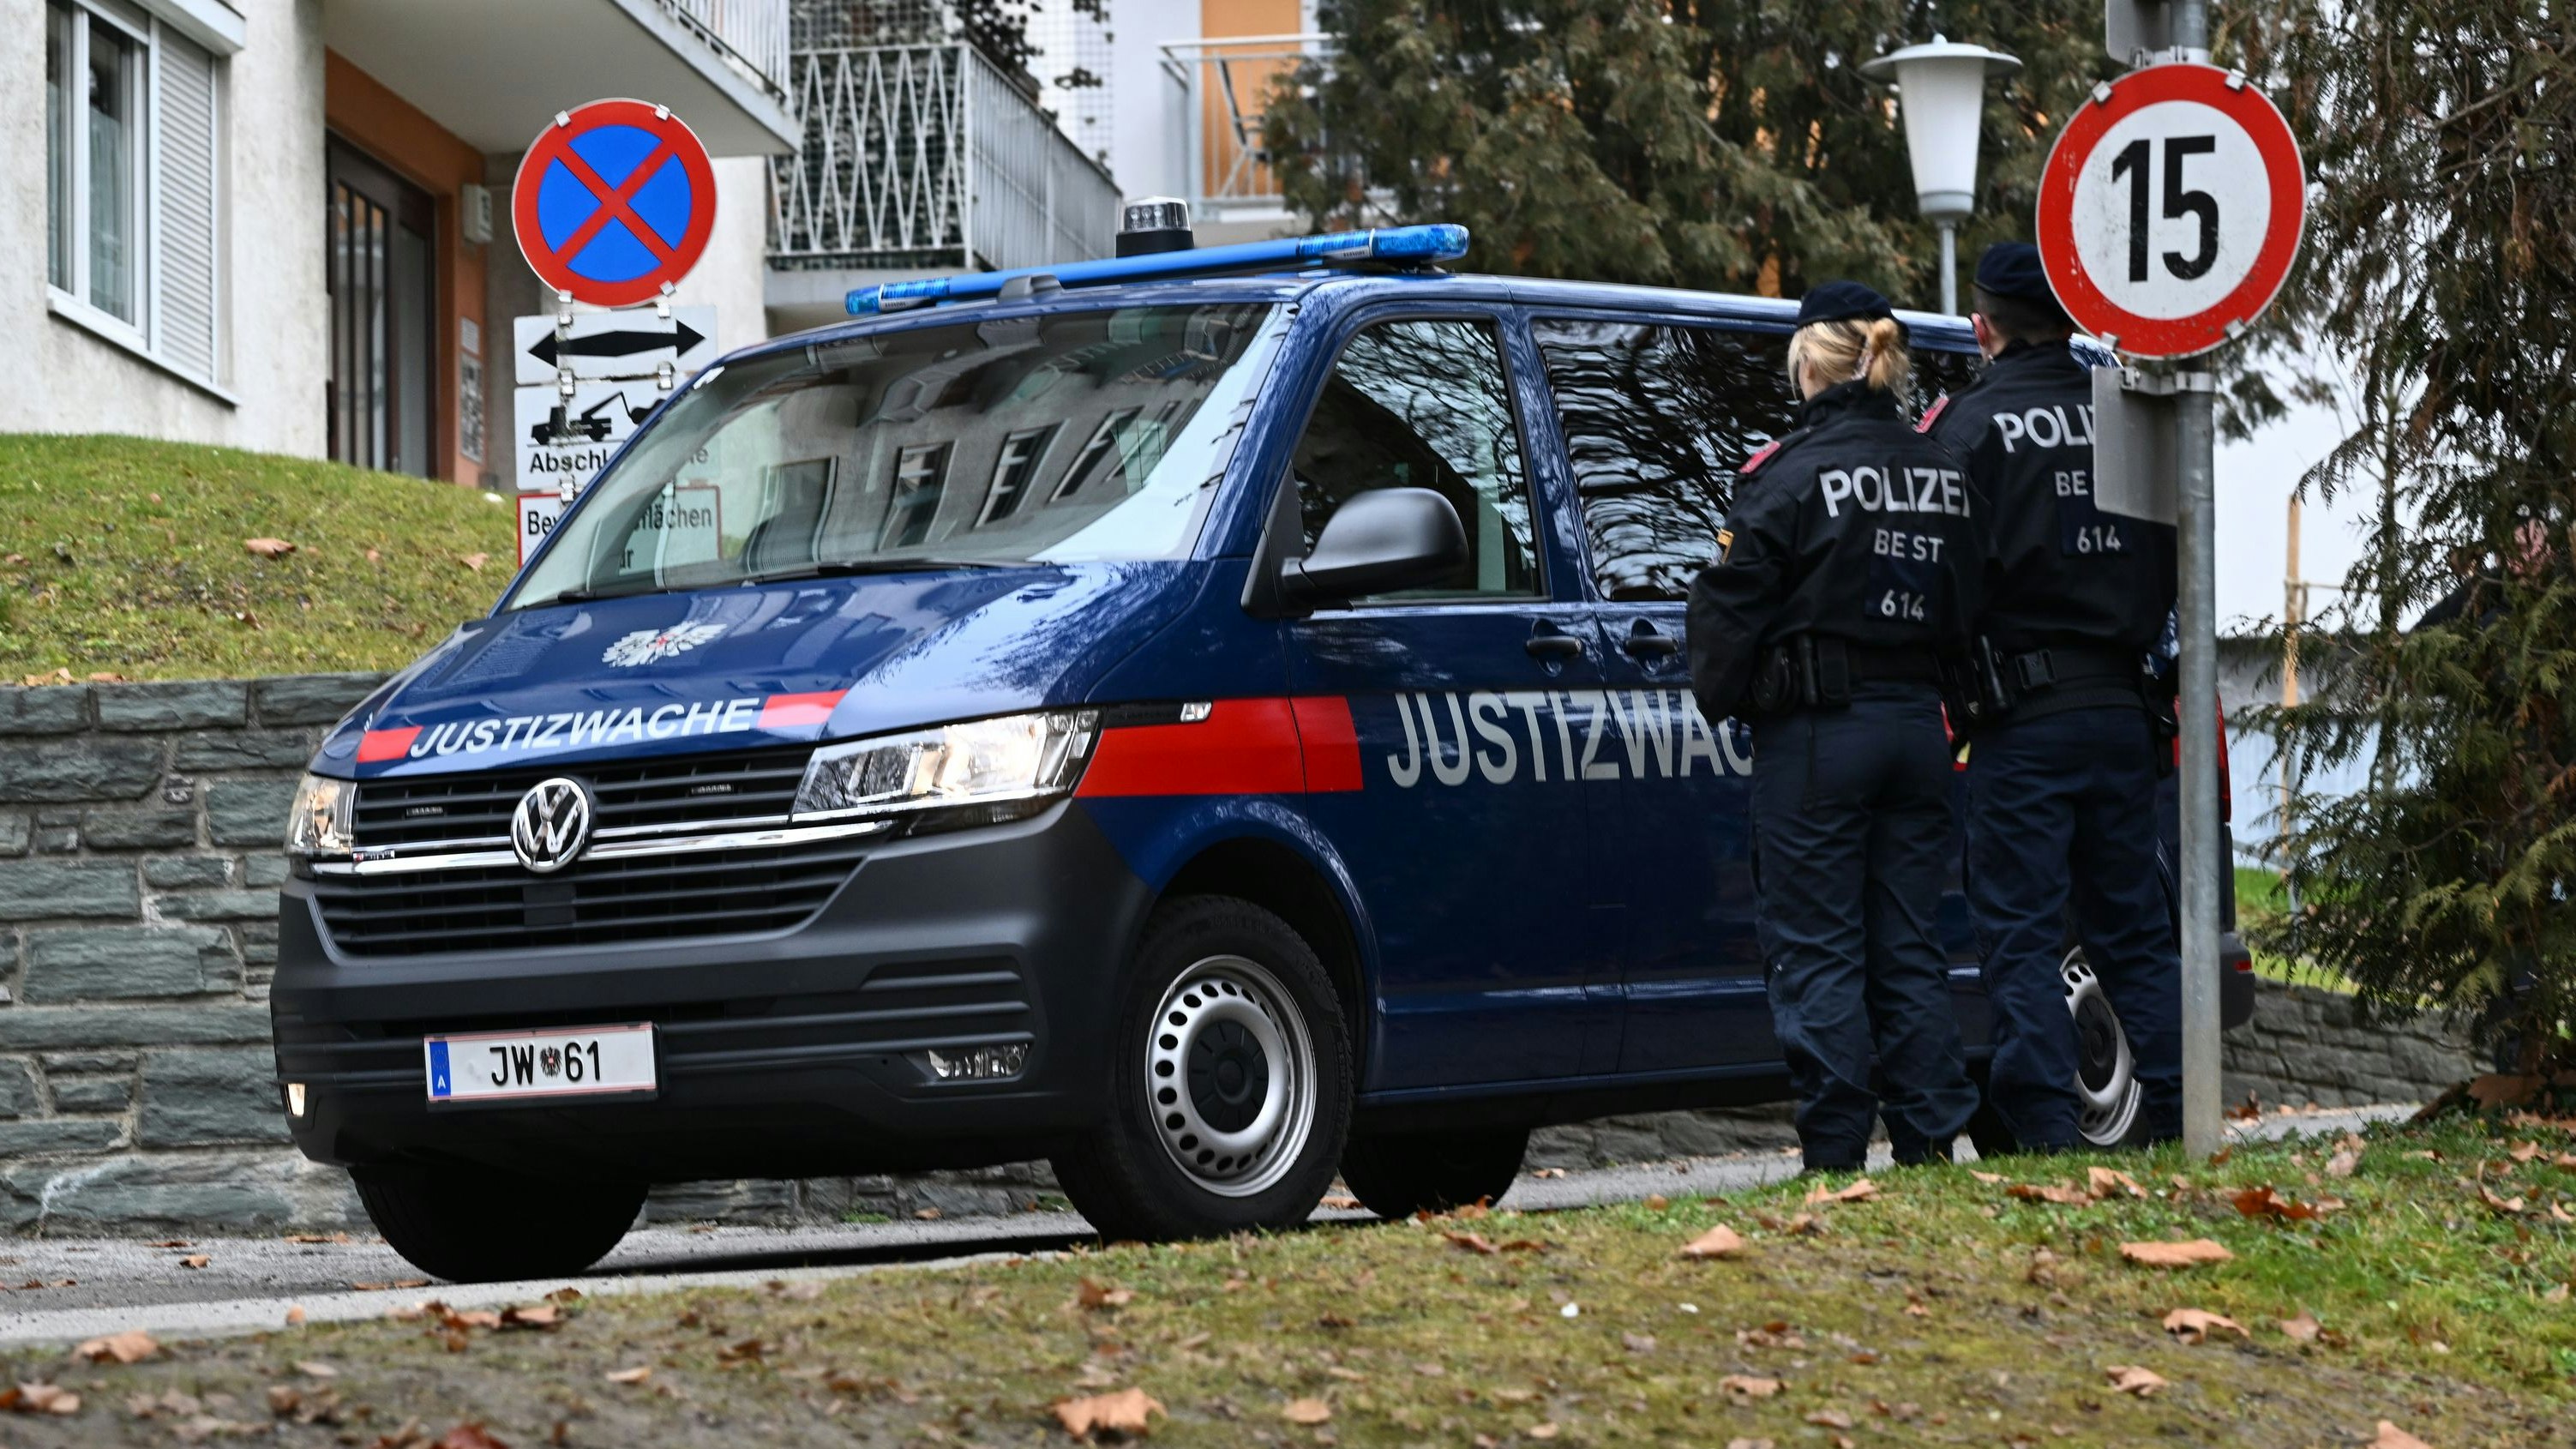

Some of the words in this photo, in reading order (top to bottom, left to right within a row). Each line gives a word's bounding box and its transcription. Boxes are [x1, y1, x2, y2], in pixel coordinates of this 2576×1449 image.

[2112, 135, 2219, 282] 15
[1992, 405, 2093, 453] POLI
[2055, 470, 2088, 496] BE
[1874, 528, 1906, 557] BE
[1912, 537, 1943, 563] ST
[2077, 526, 2121, 553] 614
[1881, 589, 1924, 621] 614
[410, 698, 760, 758] JUSTIZWACHE
[1387, 689, 1754, 788] JUSTIZWAC
[437, 1075, 446, 1089] A
[489, 1045, 534, 1086] JW
[564, 1037, 600, 1083] 61
